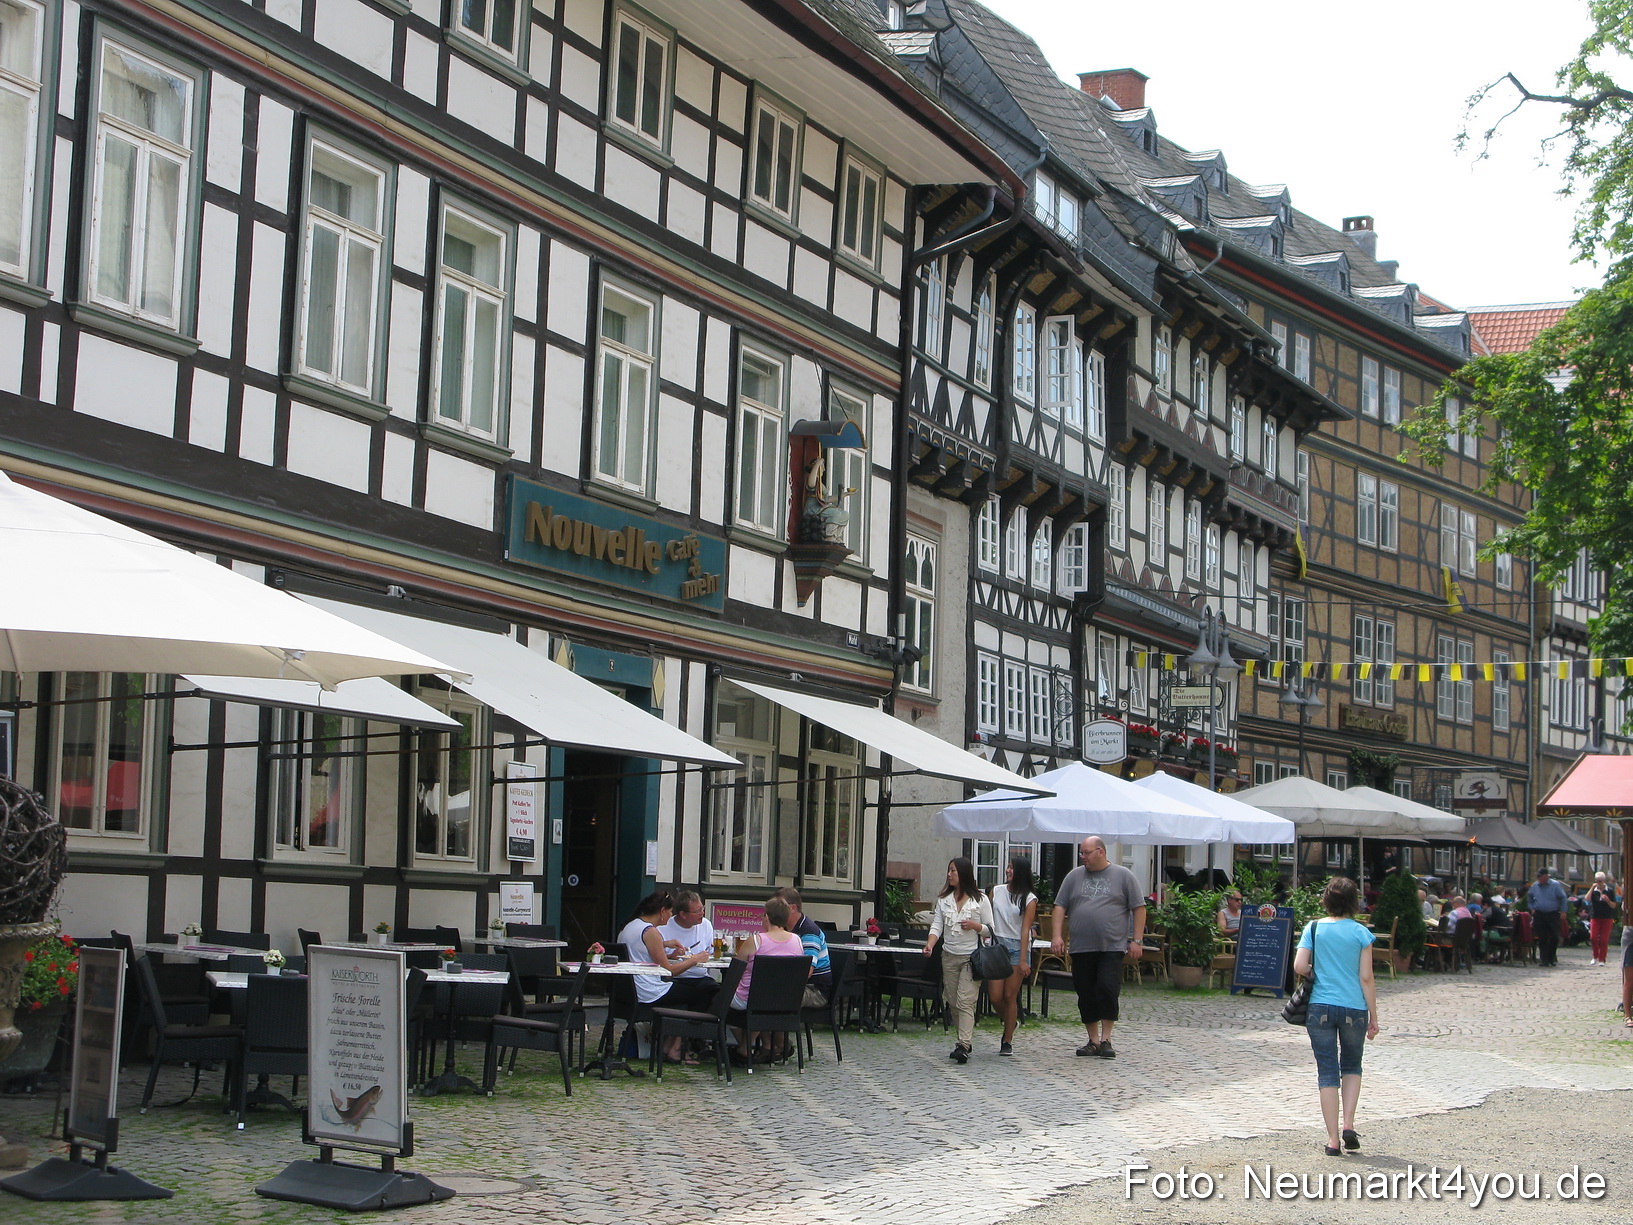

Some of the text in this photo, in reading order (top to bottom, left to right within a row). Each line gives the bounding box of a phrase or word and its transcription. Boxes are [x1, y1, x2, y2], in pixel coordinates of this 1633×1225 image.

[525, 501, 701, 574] Nouvelle café
[688, 558, 701, 577] &
[681, 573, 721, 599] mehr
[1100, 738, 1119, 746] Markt
[717, 908, 754, 918] Nouvelle
[331, 969, 379, 982] KAISERWORTH
[332, 992, 381, 1006] Frische Forelle
